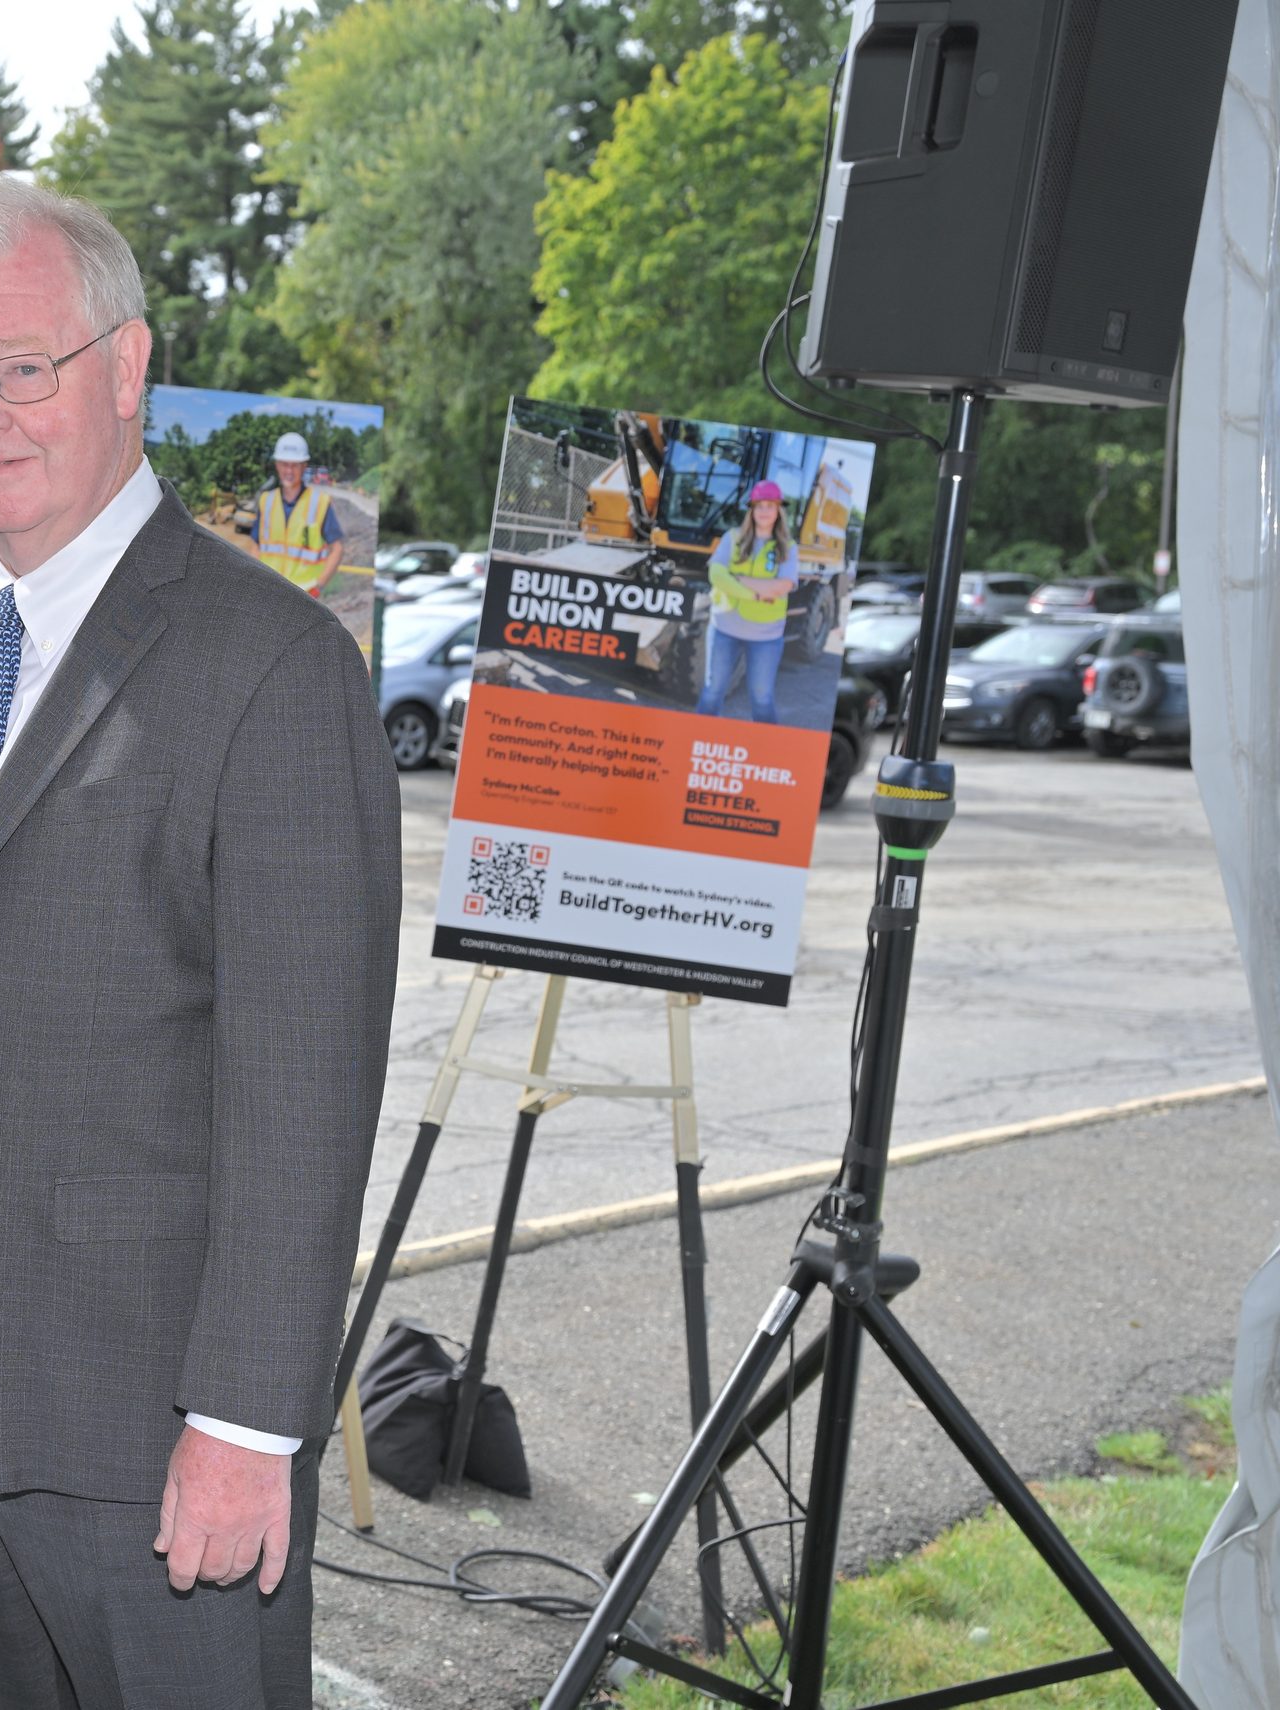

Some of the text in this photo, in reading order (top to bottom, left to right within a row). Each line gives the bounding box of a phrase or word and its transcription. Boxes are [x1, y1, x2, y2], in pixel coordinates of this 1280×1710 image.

[510, 569, 685, 616] BUILD YOUR
[507, 594, 604, 631] UNION
[503, 621, 627, 660] CAREER.
[489, 731, 564, 752] community.
[567, 742, 593, 756] And
[596, 744, 628, 761] right
[514, 716, 546, 732] from
[549, 721, 597, 739] Croton.
[602, 728, 628, 743] This
[631, 732, 641, 745] is
[644, 738, 664, 750] my
[486, 747, 506, 760] I'm
[509, 748, 559, 769] literally
[561, 758, 609, 777] helping
[612, 765, 644, 780] build
[692, 740, 748, 762] BUILD
[482, 777, 517, 792] Sydney
[688, 773, 743, 794] BUILD
[691, 757, 797, 786] TOGETHER.
[686, 790, 760, 813] BETTER.
[688, 812, 776, 833] UNION STRONG.
[563, 871, 775, 909] Scan the QR code to watch Sydney's video.
[559, 890, 774, 938] BuildTogetherHV.org
[460, 937, 528, 956] CONSTRUCTION
[529, 948, 570, 961] INDUSTRY
[570, 953, 609, 967] COUNCIL
[610, 959, 622, 969] OF
[623, 960, 684, 977] WESTCHESTER
[693, 971, 731, 984] HUDSON
[731, 977, 765, 990] VALLEY
